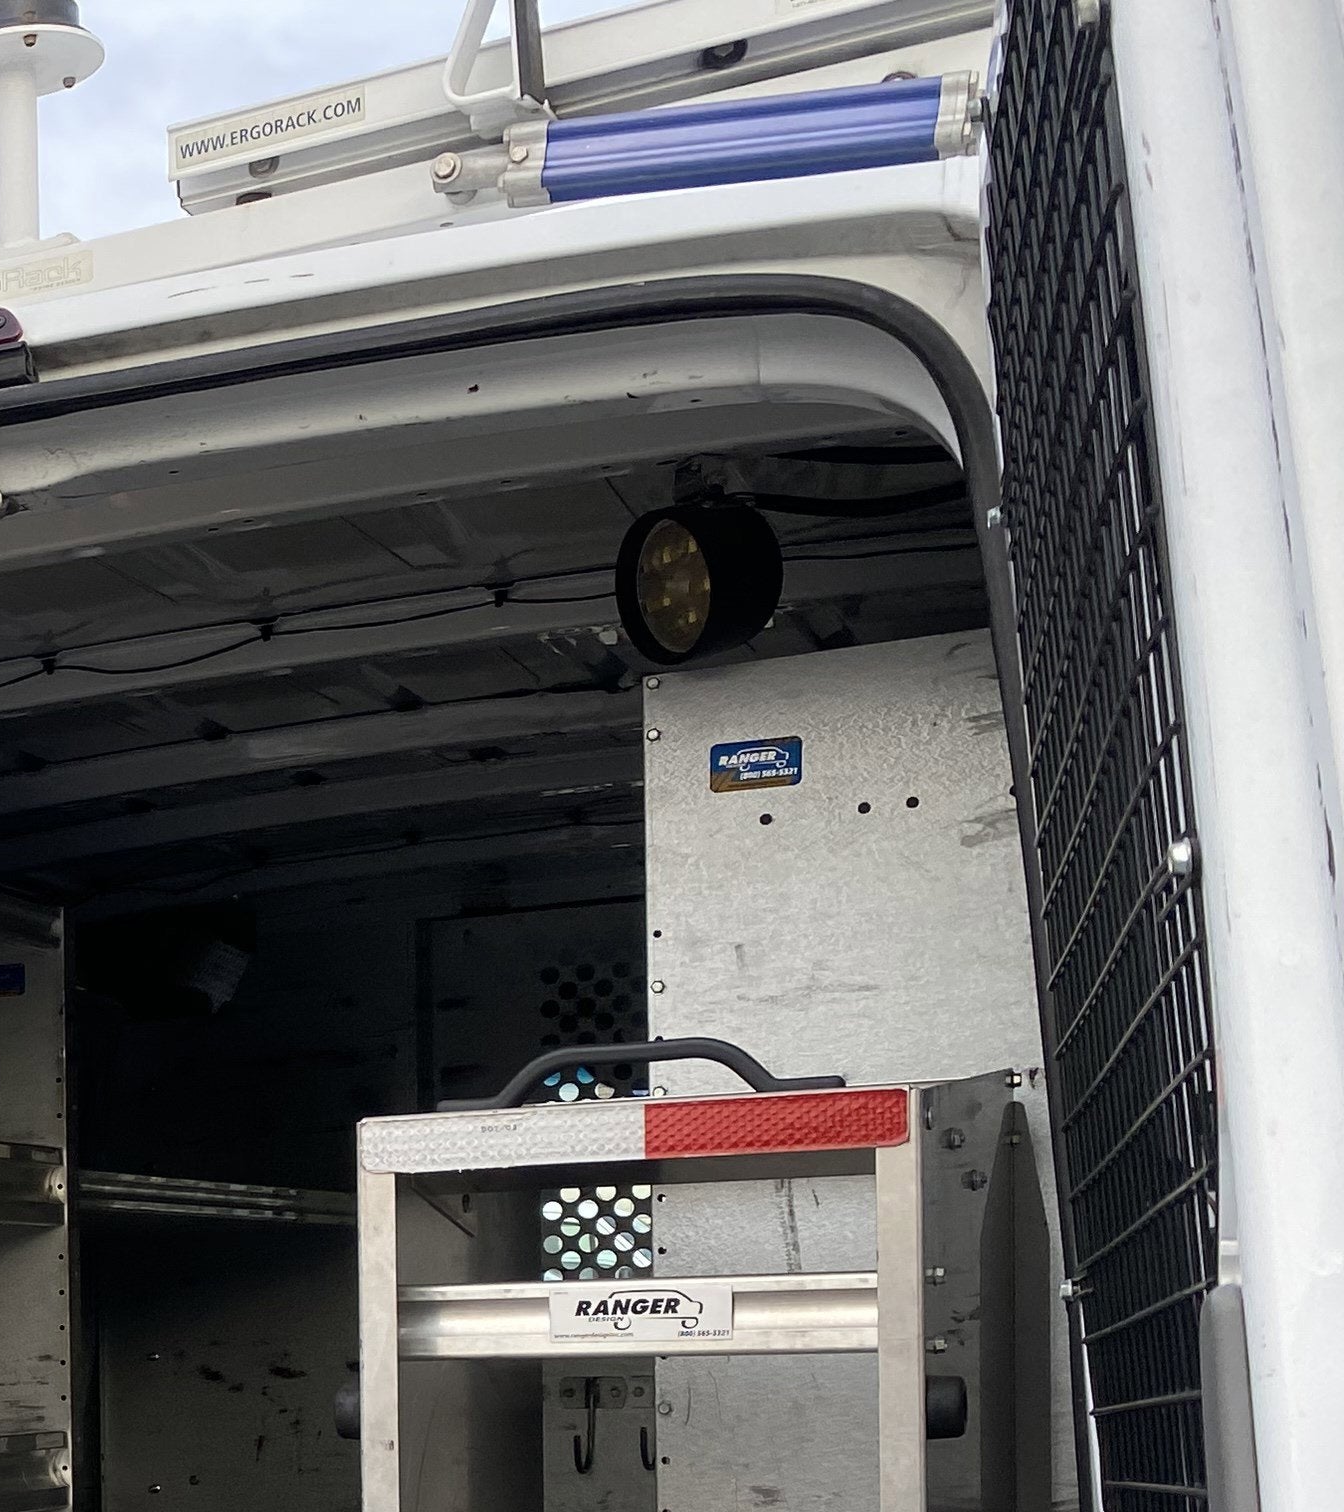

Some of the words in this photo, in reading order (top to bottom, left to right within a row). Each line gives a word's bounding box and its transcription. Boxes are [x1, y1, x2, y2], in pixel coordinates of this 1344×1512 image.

[180, 97, 361, 159] WWW.ERGORACK.COM
[718, 751, 777, 766] RANGER
[575, 1298, 681, 1316] RANGER
